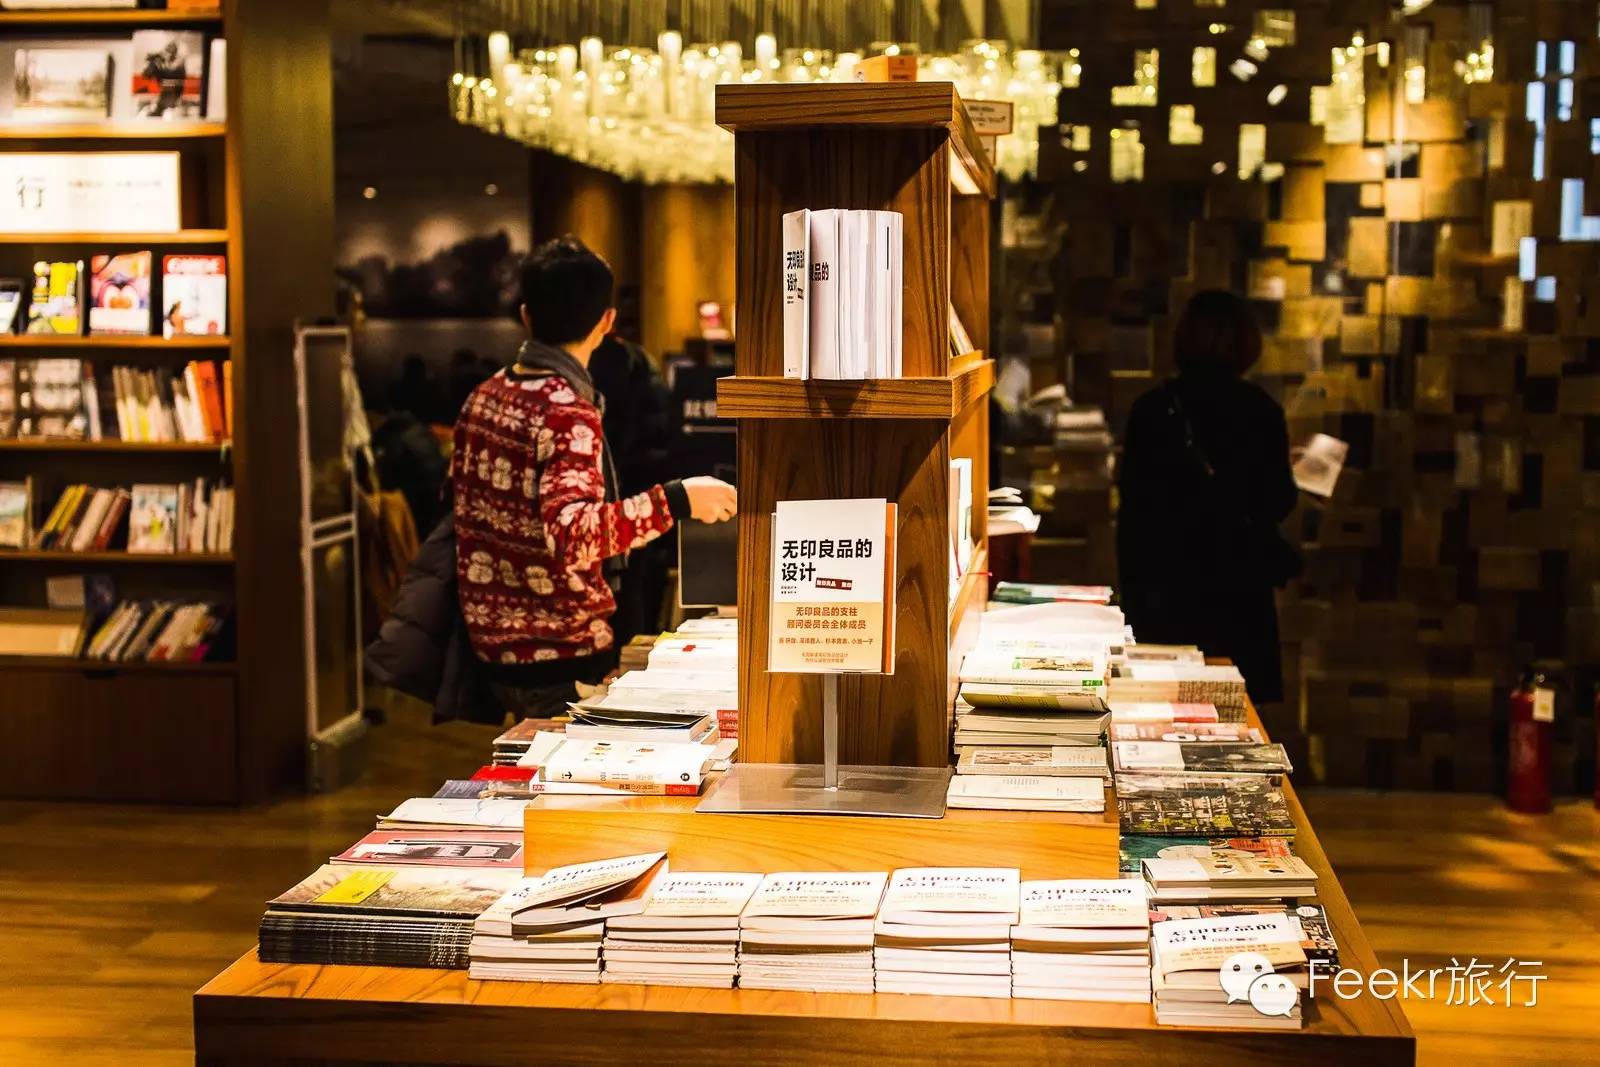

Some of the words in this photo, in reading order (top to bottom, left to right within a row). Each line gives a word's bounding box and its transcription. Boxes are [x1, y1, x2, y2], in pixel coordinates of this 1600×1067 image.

[782, 538, 873, 559] 无印良品的
[781, 562, 816, 582] 设计
[795, 606, 858, 617] 无印良品的支柱
[786, 619, 867, 630] 顾问委员会全体成员
